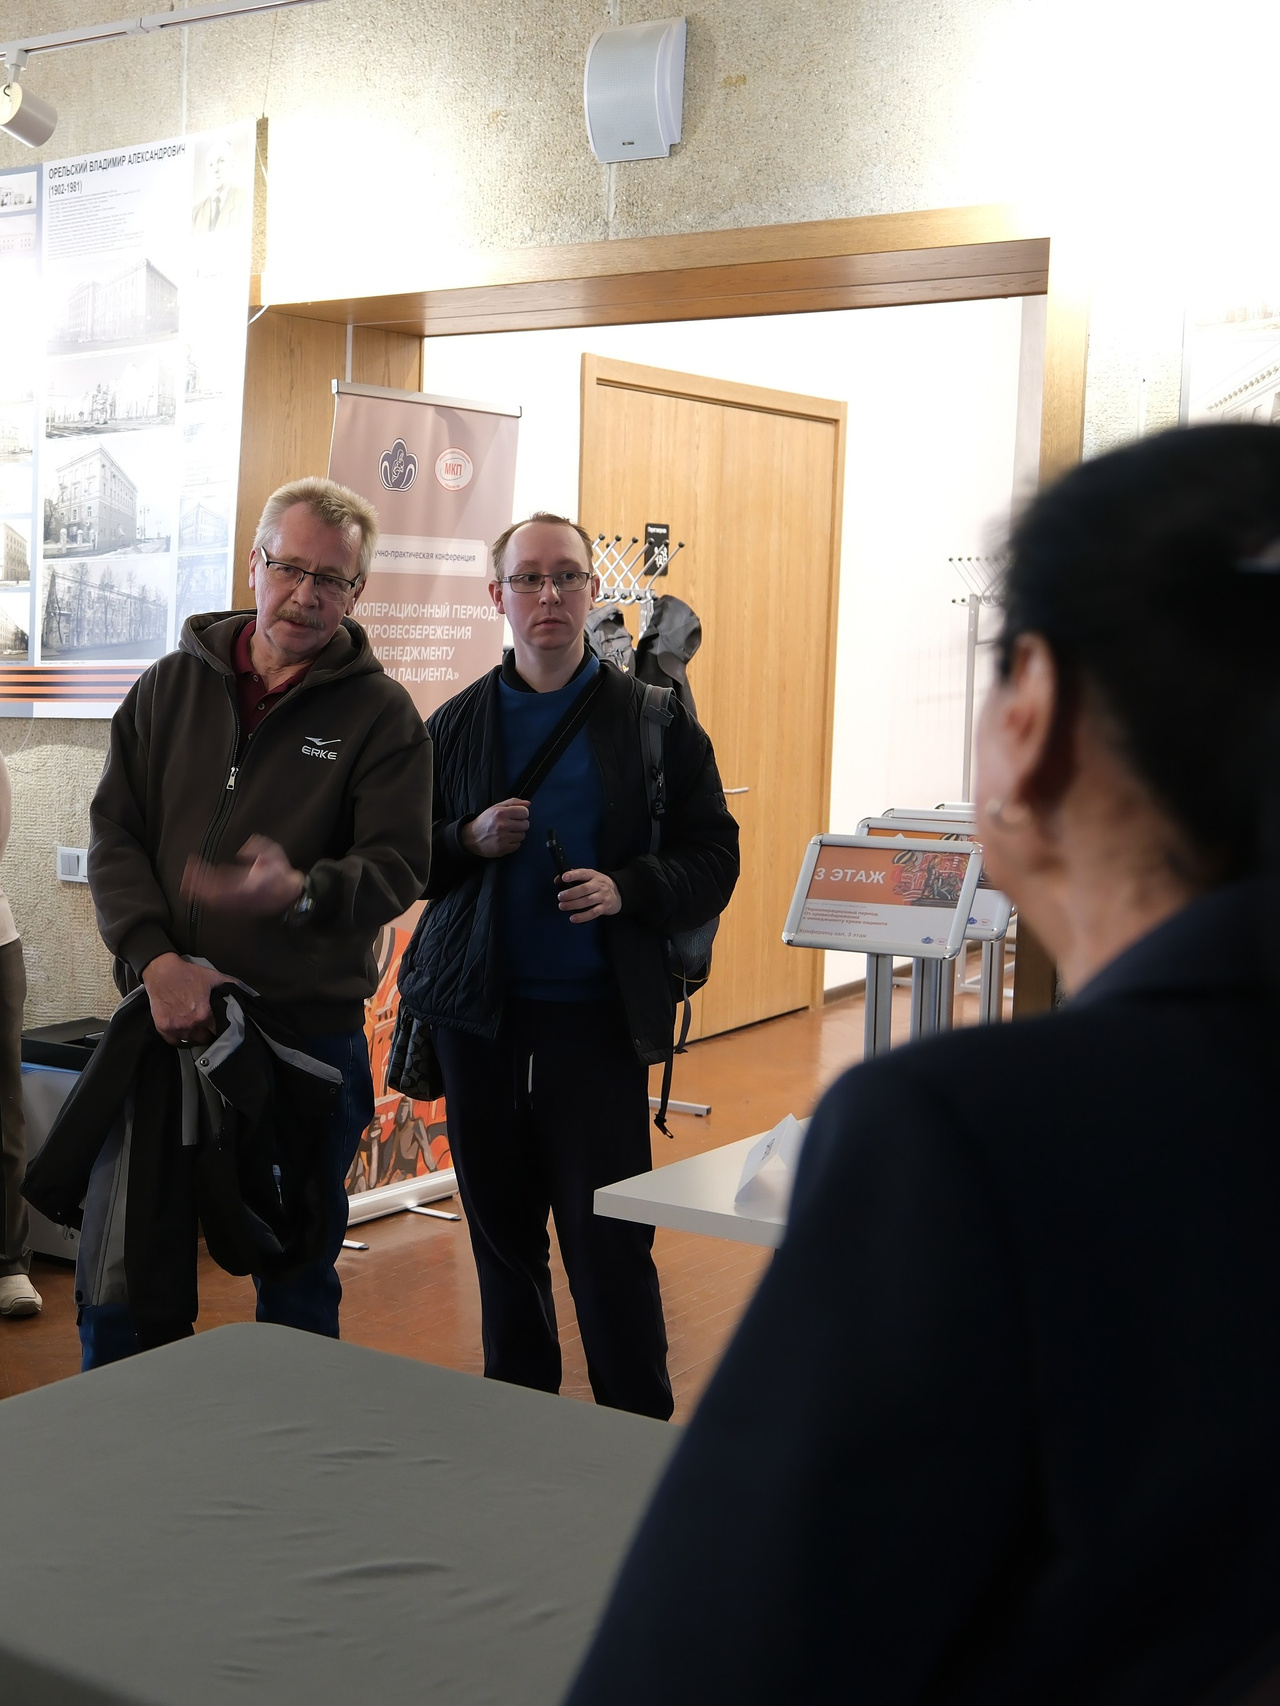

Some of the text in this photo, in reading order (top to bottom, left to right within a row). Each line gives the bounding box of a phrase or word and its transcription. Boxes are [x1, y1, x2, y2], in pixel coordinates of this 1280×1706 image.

[48, 143, 186, 179] ОРЕЛЬСКИЙ ВЛАДИМИР АЛЕКСАНДРОВИЧ
[48, 180, 82, 199] (1902-1981)
[444, 463, 462, 476] МКП
[374, 549, 476, 563] учно-практическая конференция
[353, 601, 450, 620] ИОПЕРАЦИОННЫЙ
[367, 623, 472, 640] КРОВЕСБЕРЕЖЕНИЯ
[373, 645, 455, 662] МЕНЕДЖМЕНТУ
[397, 667, 460, 684] ПАЦИЕНТА»
[301, 745, 337, 760] ERKE
[814, 867, 886, 884] 3 ЭТАЖ
